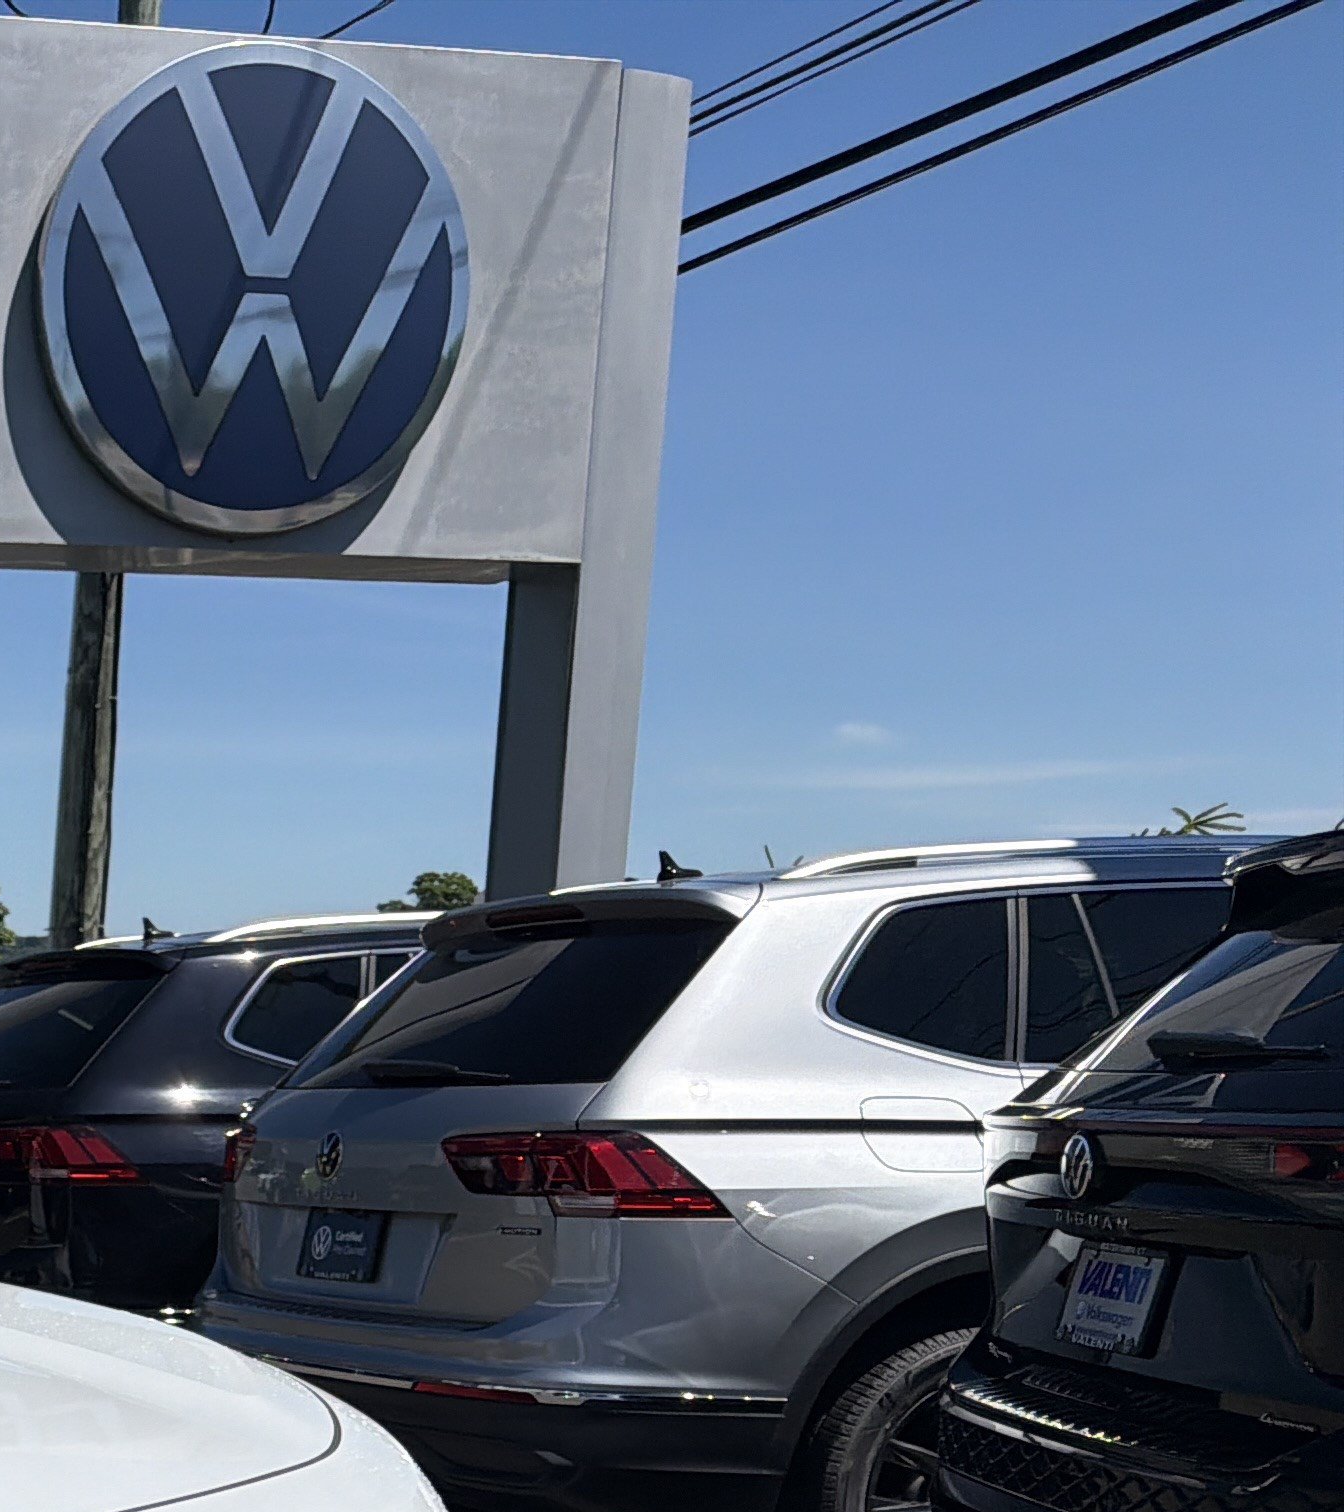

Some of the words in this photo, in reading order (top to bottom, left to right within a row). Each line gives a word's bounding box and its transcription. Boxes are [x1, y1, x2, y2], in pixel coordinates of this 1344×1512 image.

[1055, 1209, 1130, 1231] TIGUAN
[1078, 1259, 1153, 1305] VALENTI
[1086, 1303, 1134, 1329] Volkswagen
[1072, 1333, 1115, 1351] VALENTI
